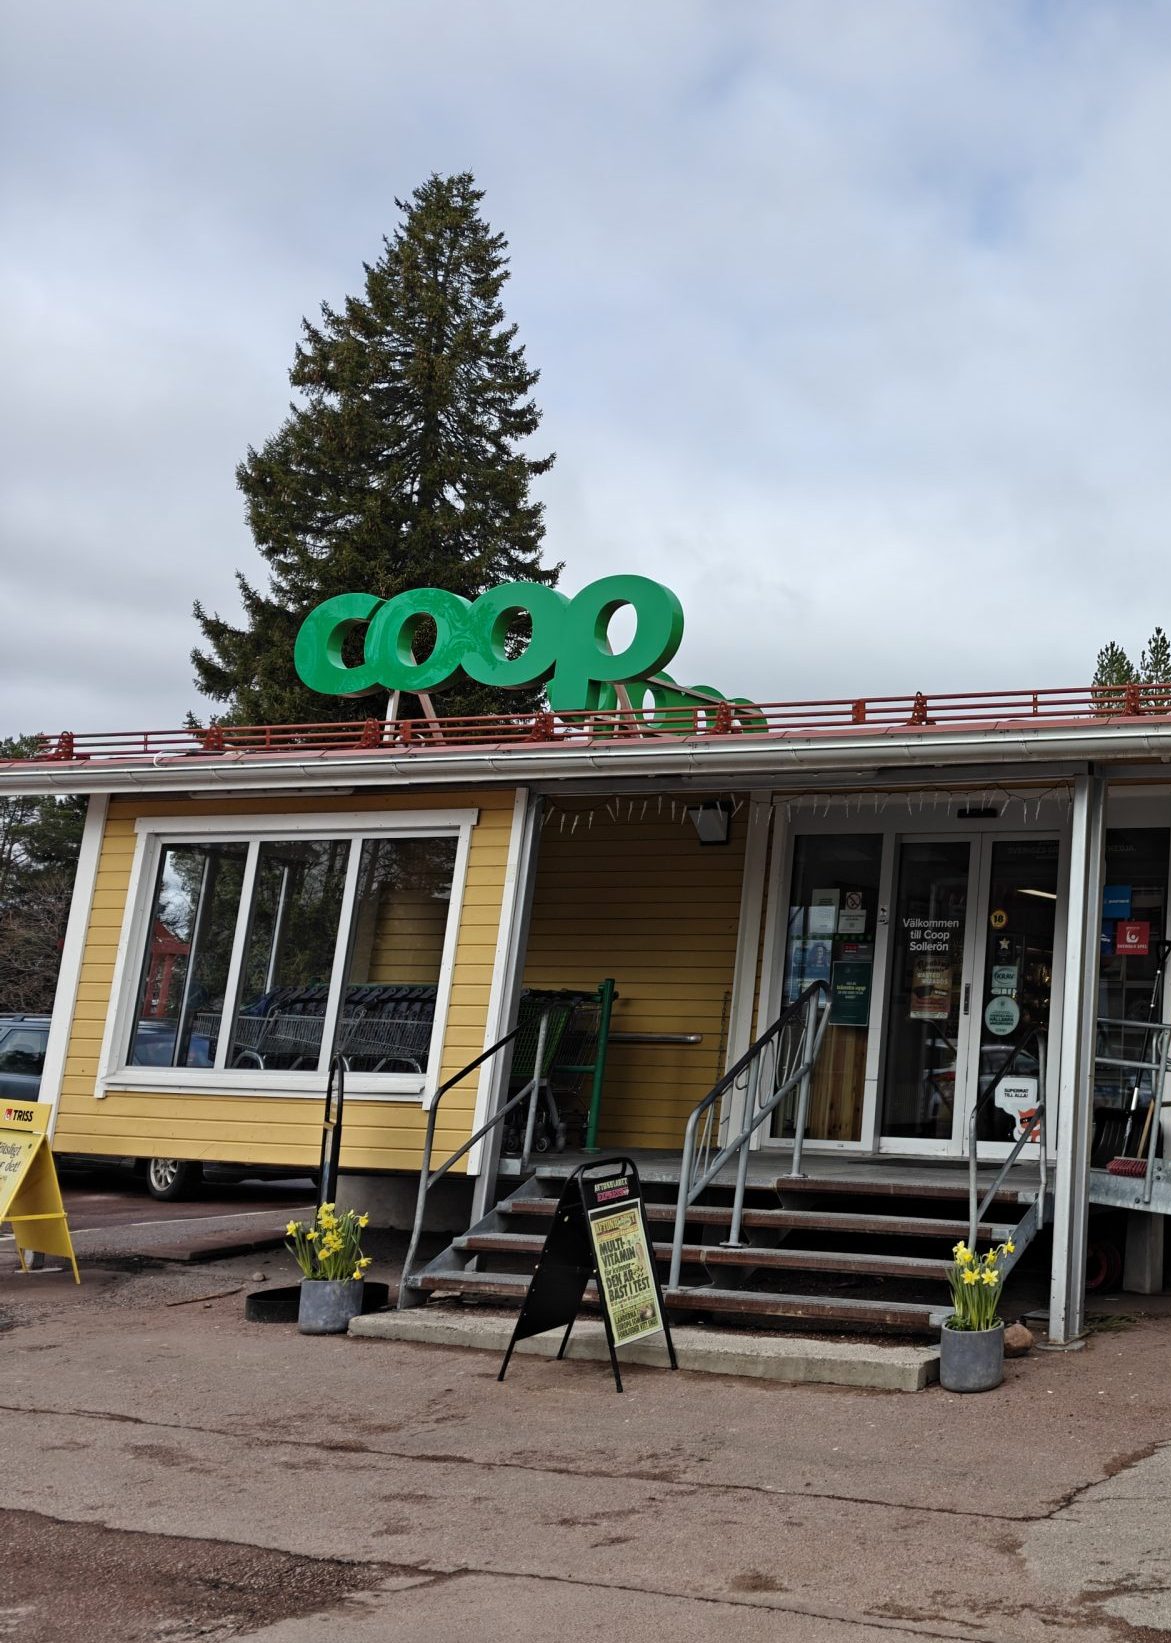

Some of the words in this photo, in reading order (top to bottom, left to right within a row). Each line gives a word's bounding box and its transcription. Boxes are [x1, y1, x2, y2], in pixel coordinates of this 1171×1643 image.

[294, 575, 685, 713] coop
[902, 918, 960, 928] Välkommen
[910, 930, 921, 940] till
[923, 930, 950, 941] Coop
[909, 941, 949, 951] Sollerön
[12, 1109, 34, 1122] TRISS
[599, 1236, 626, 1256] MULTI-
[600, 1246, 636, 1268] VITAMIN
[605, 1272, 623, 1290] DEN
[633, 1276, 650, 1293] TEST
